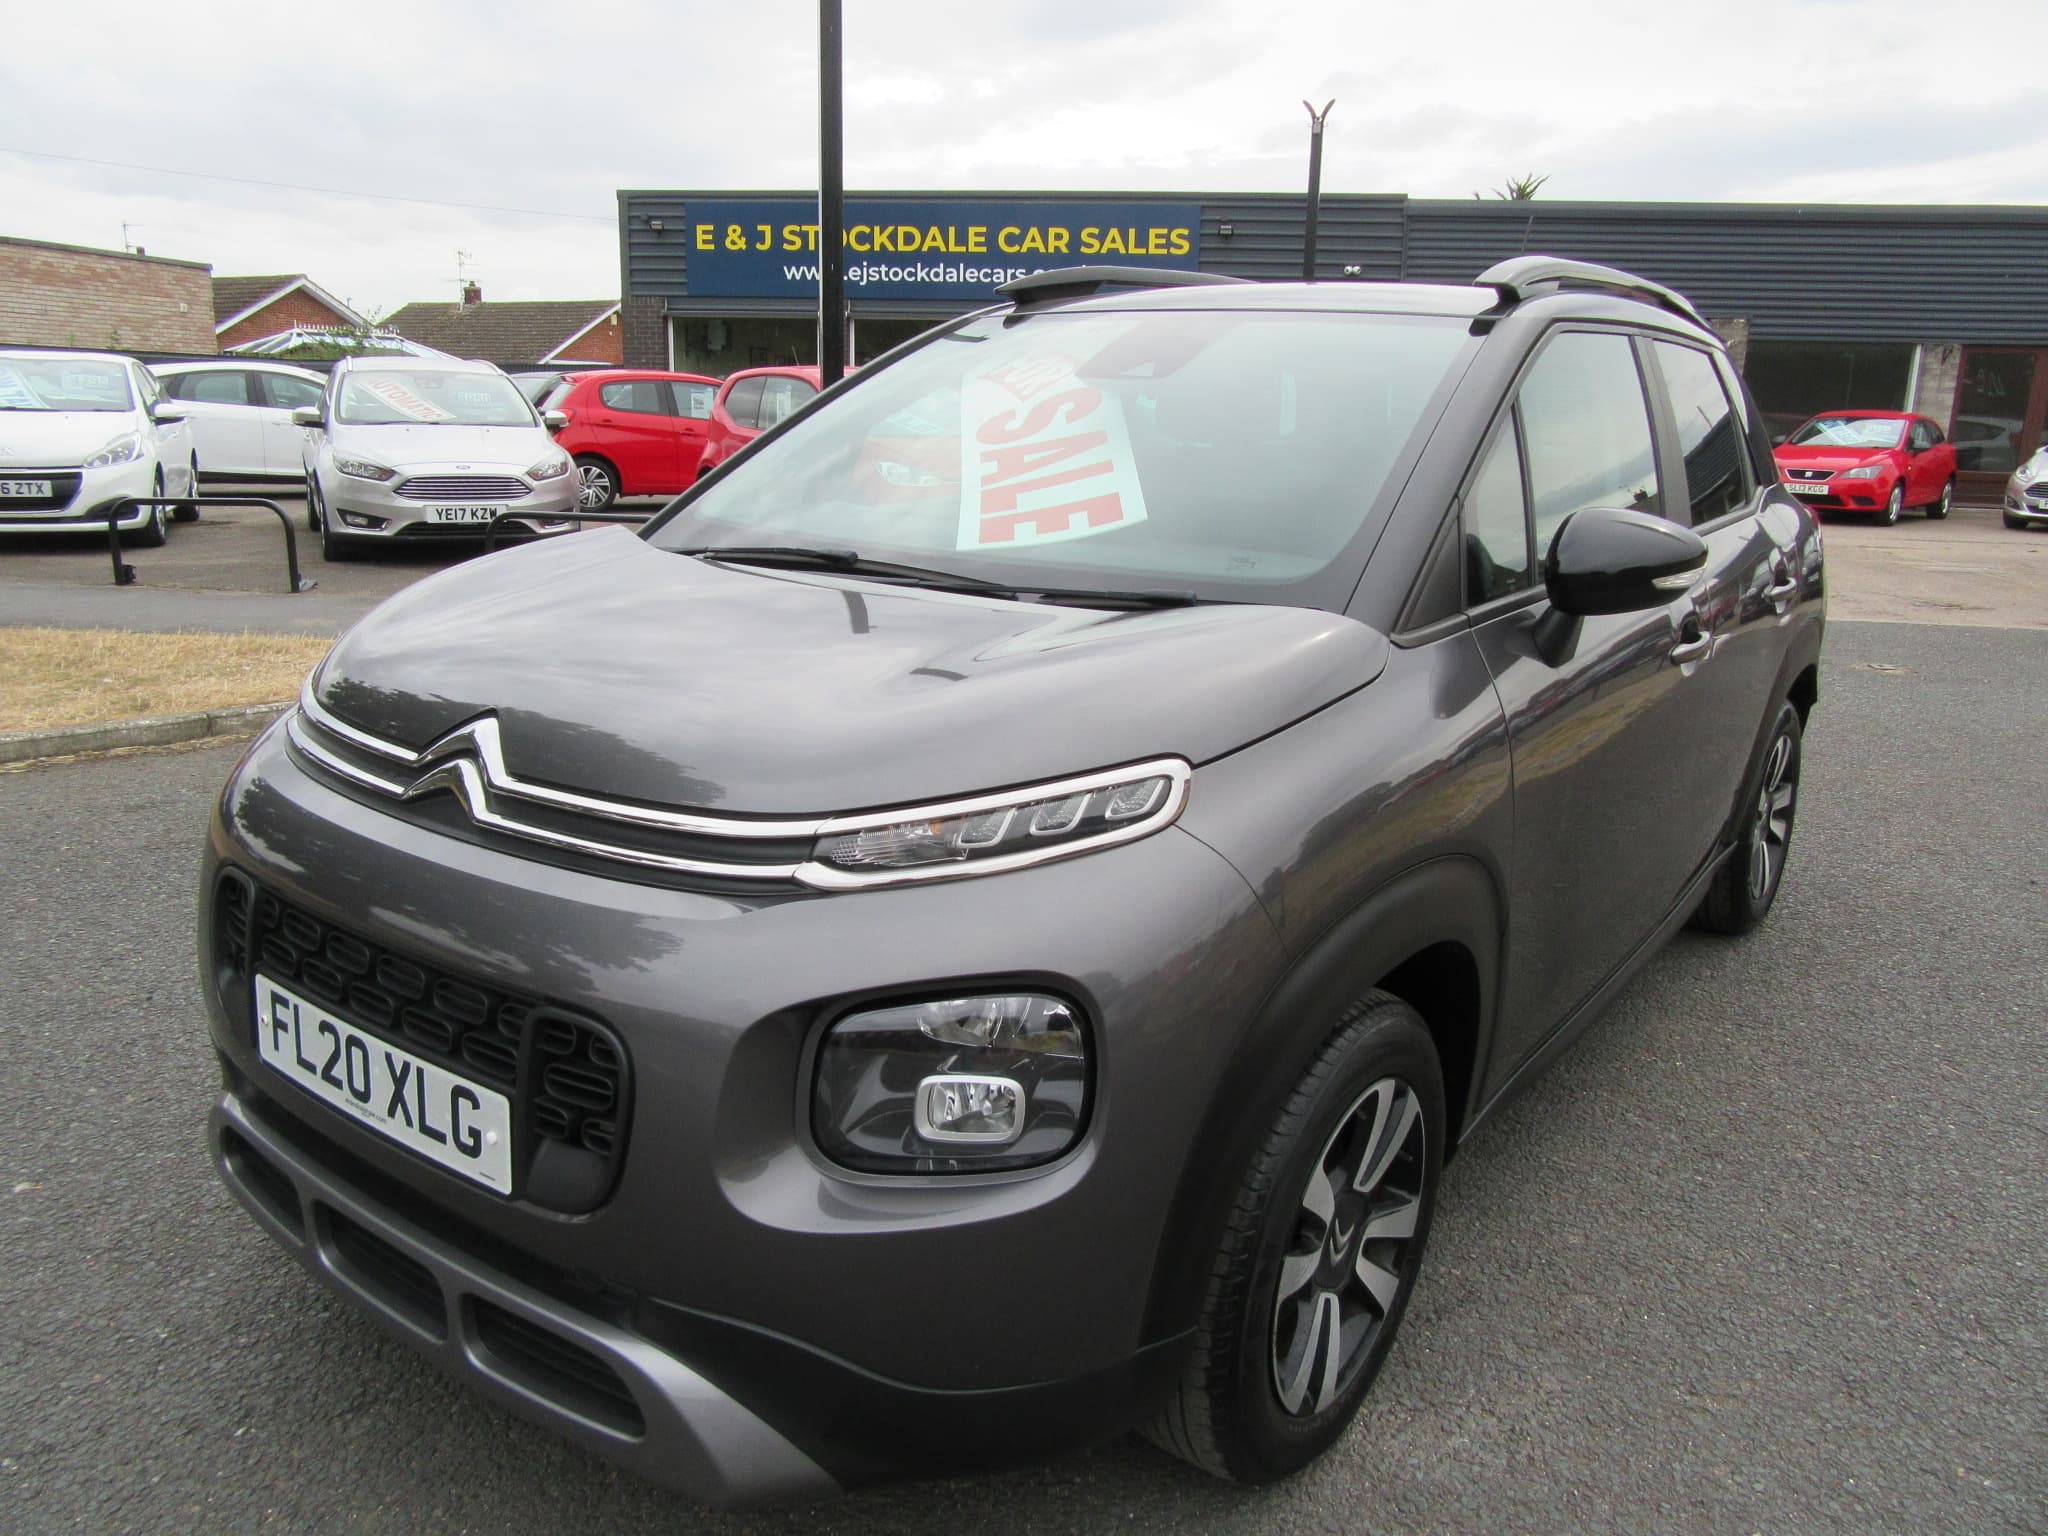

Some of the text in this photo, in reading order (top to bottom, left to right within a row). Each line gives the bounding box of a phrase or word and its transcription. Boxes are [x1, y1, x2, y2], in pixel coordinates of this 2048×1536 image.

[695, 224, 1191, 255] E & J STCKDALE CAR SALES
[975, 386, 1124, 544] SALE
[14, 482, 45, 495] ZTX
[435, 507, 498, 521] YE17 KZW
[270, 988, 483, 1160] FL20 XLG
